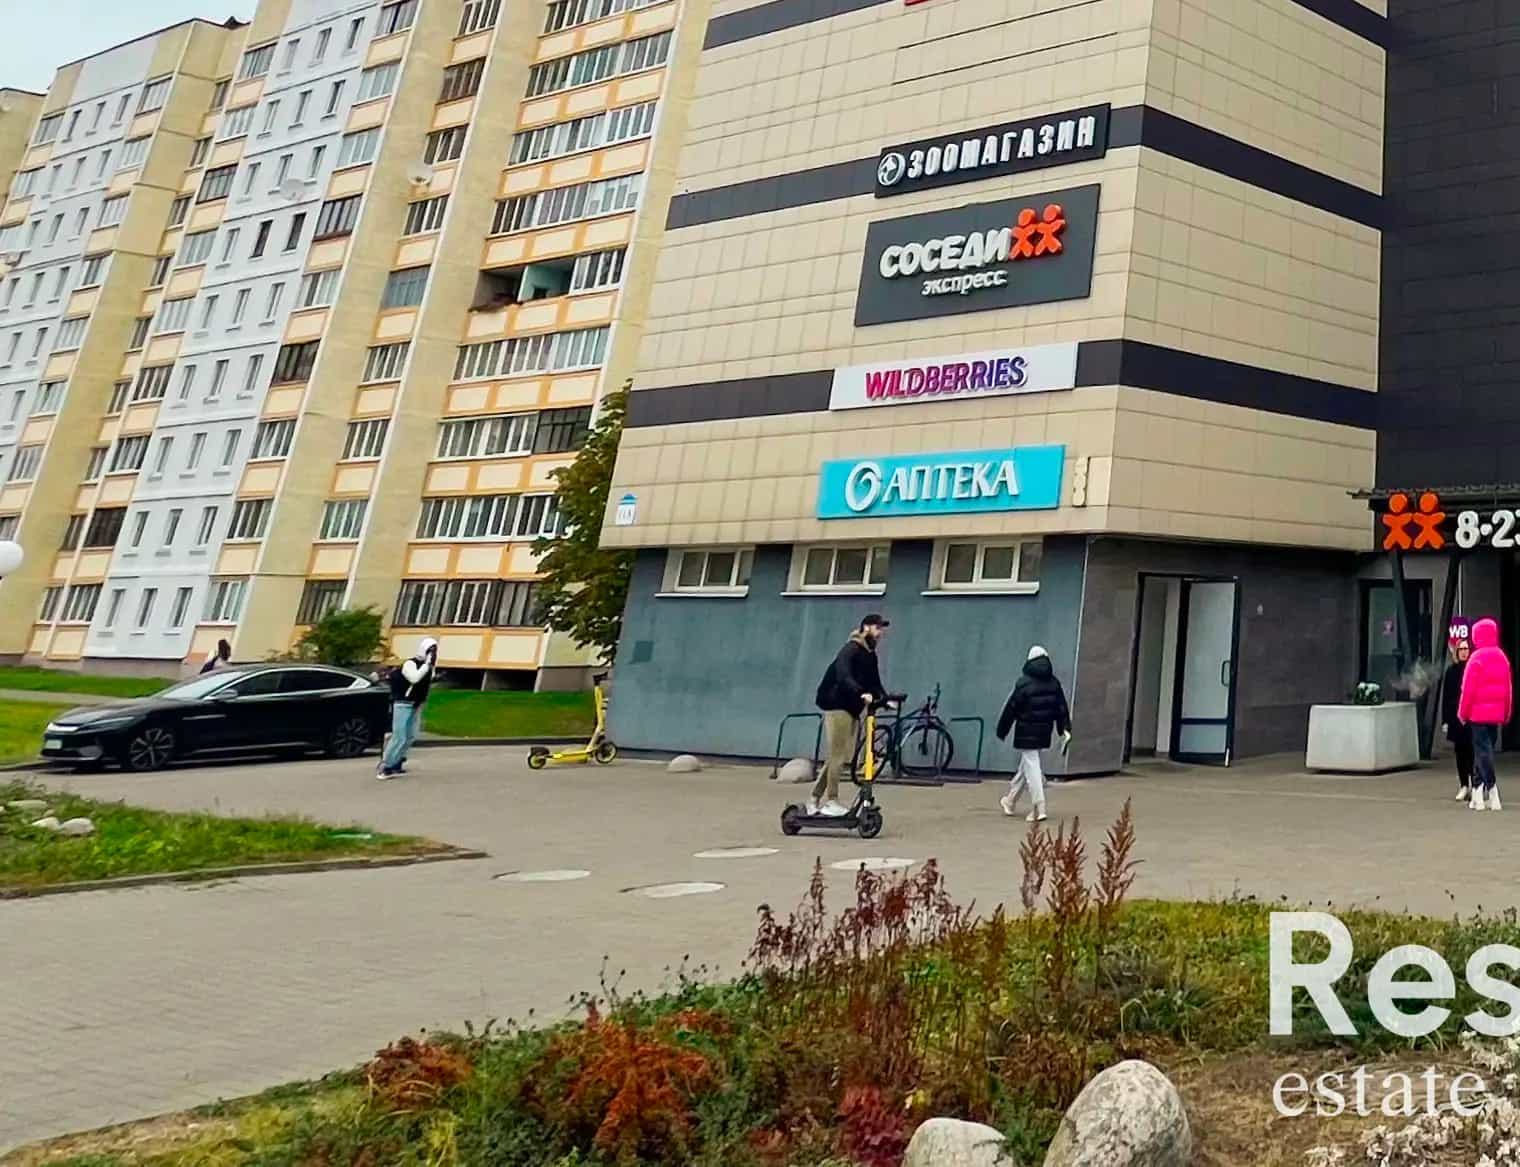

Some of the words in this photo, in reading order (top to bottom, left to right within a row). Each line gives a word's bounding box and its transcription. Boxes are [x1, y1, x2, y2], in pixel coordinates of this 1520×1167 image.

[907, 116, 1095, 178] ЗООМАГАЗИН
[880, 228, 1011, 278] СОСЕДИ
[921, 270, 1008, 295] экспресс
[866, 356, 1028, 400] WILDBERRIES
[882, 460, 1019, 503] АПТЕКА
[1449, 624, 1468, 638] WB
